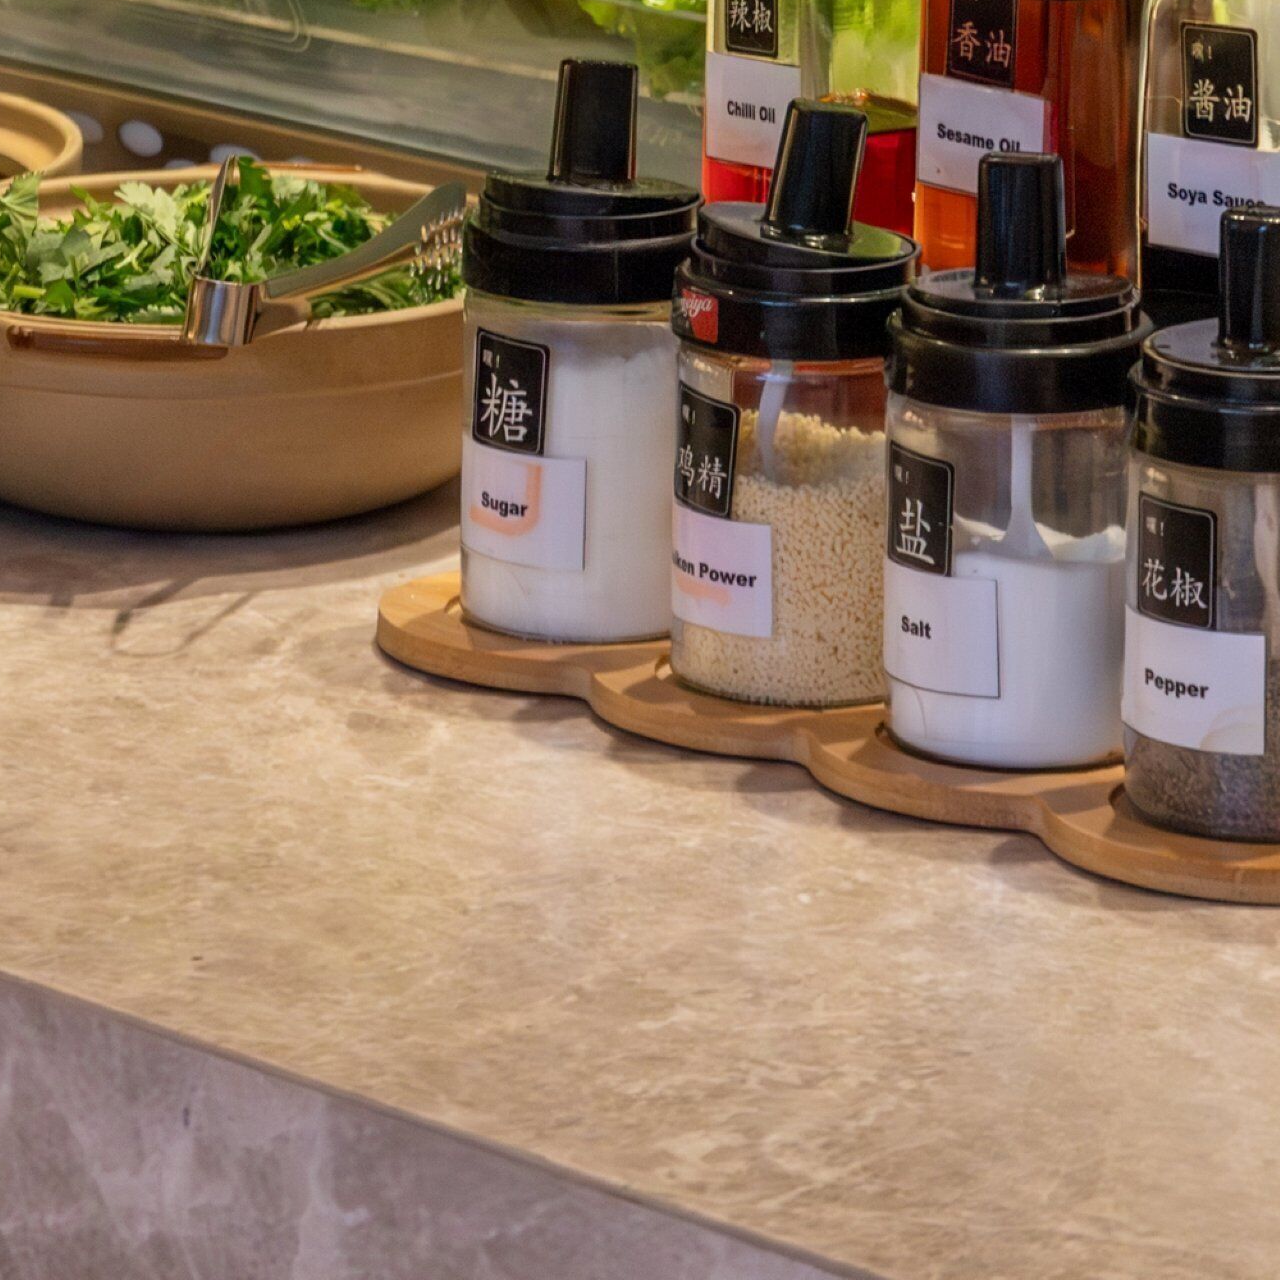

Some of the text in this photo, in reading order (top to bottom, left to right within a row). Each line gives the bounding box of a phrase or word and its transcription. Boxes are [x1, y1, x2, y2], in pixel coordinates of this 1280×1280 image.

[952, 21, 1012, 68] 香油
[727, 100, 776, 124] Chilli Oil
[1189, 79, 1253, 124] 酱油
[937, 123, 1020, 153] Sesame Oil
[1167, 182, 1208, 207] Soya
[480, 372, 533, 442] 糖
[678, 444, 727, 500] 鸡精
[481, 491, 529, 517] Sugar
[895, 497, 935, 565] 盐
[699, 561, 757, 588] Power
[1141, 558, 1208, 609] 花椒
[901, 615, 932, 640] Salt
[1144, 668, 1210, 700] Pepper
